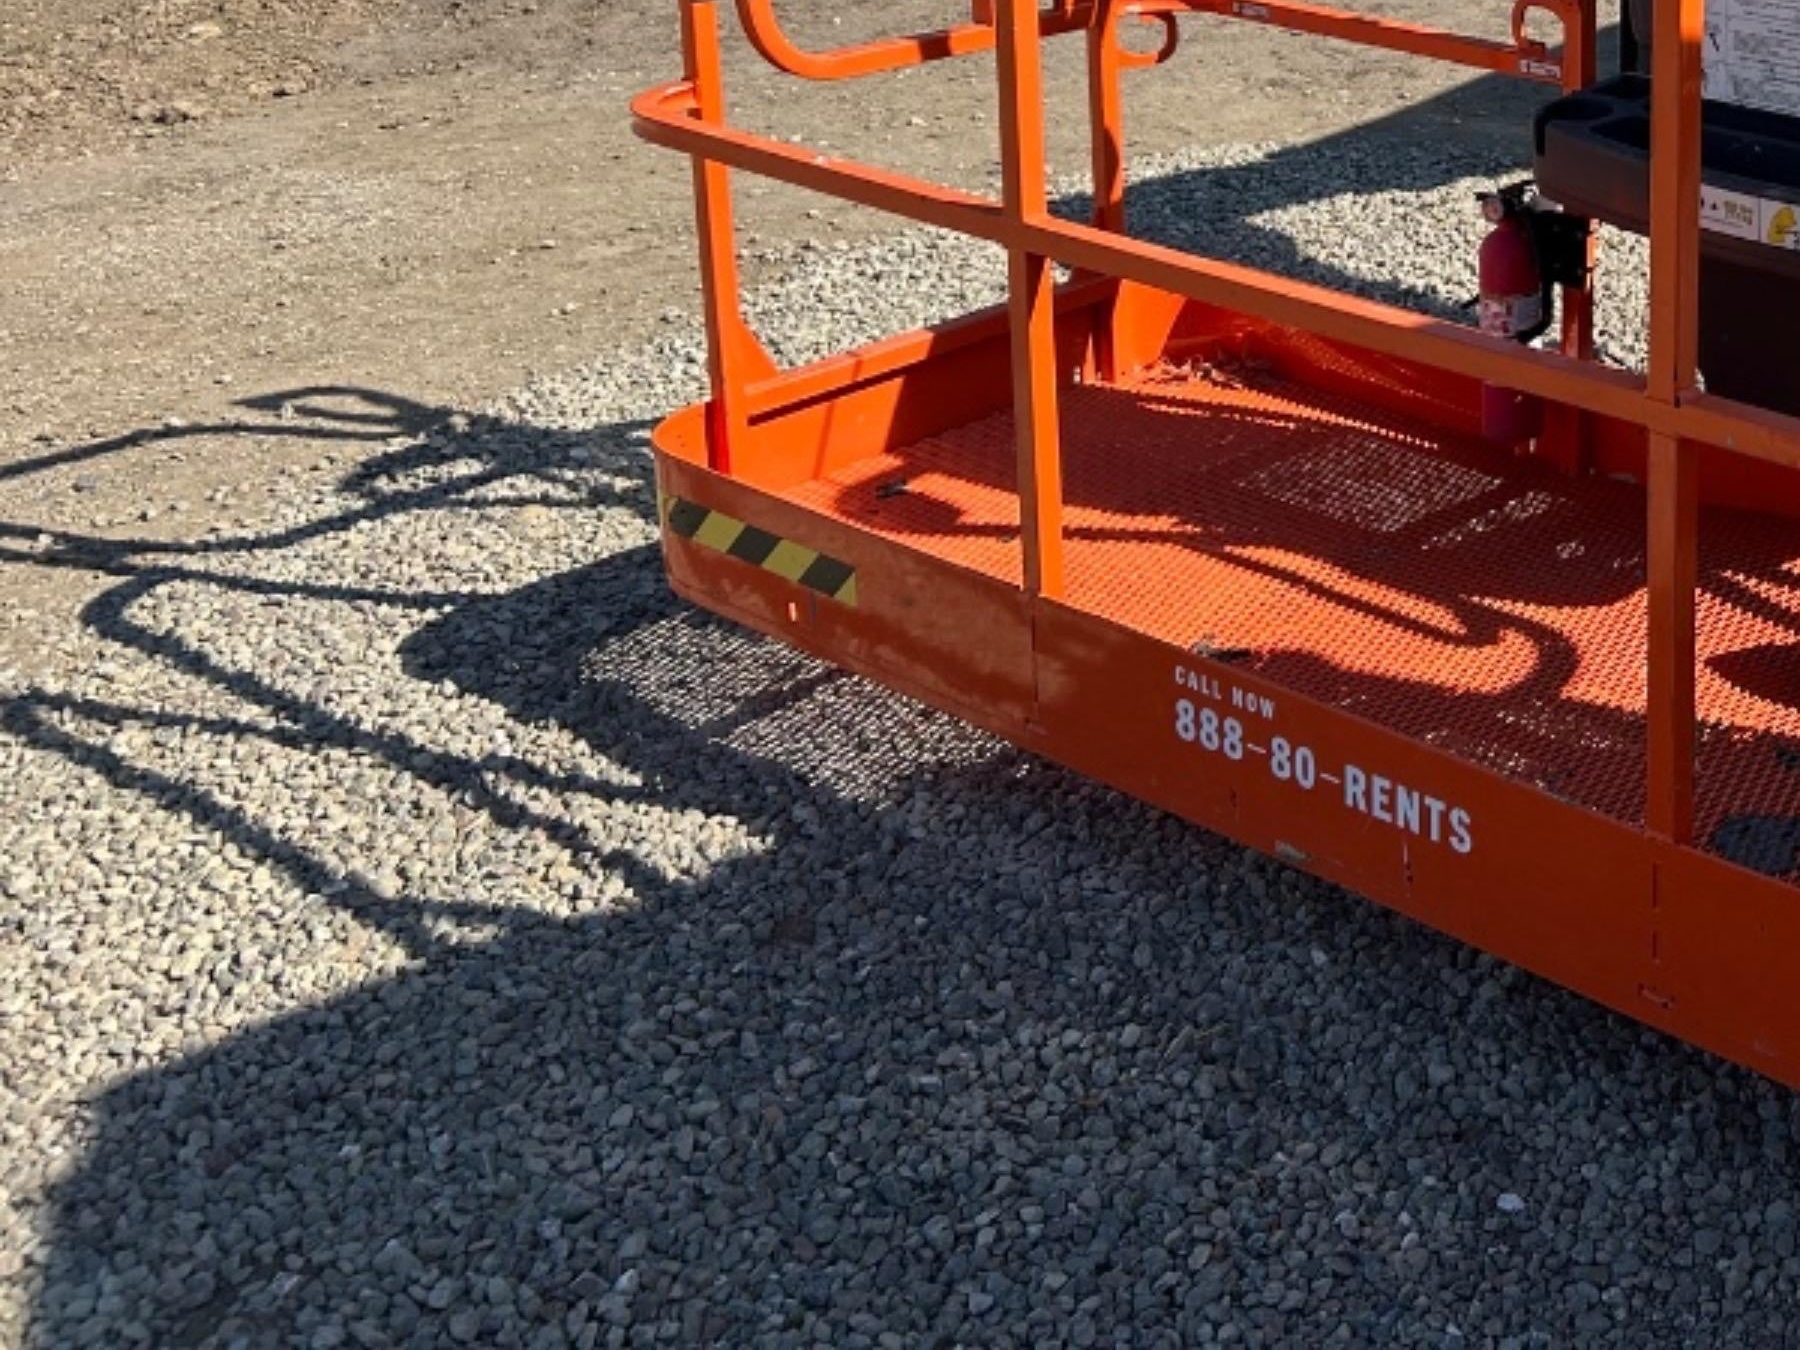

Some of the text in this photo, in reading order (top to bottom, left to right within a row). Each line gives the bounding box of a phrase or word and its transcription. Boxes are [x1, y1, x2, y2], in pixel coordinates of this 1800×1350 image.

[1174, 664, 1276, 721] CALL NOW
[1174, 698, 1473, 854] 888-80-RENTS
